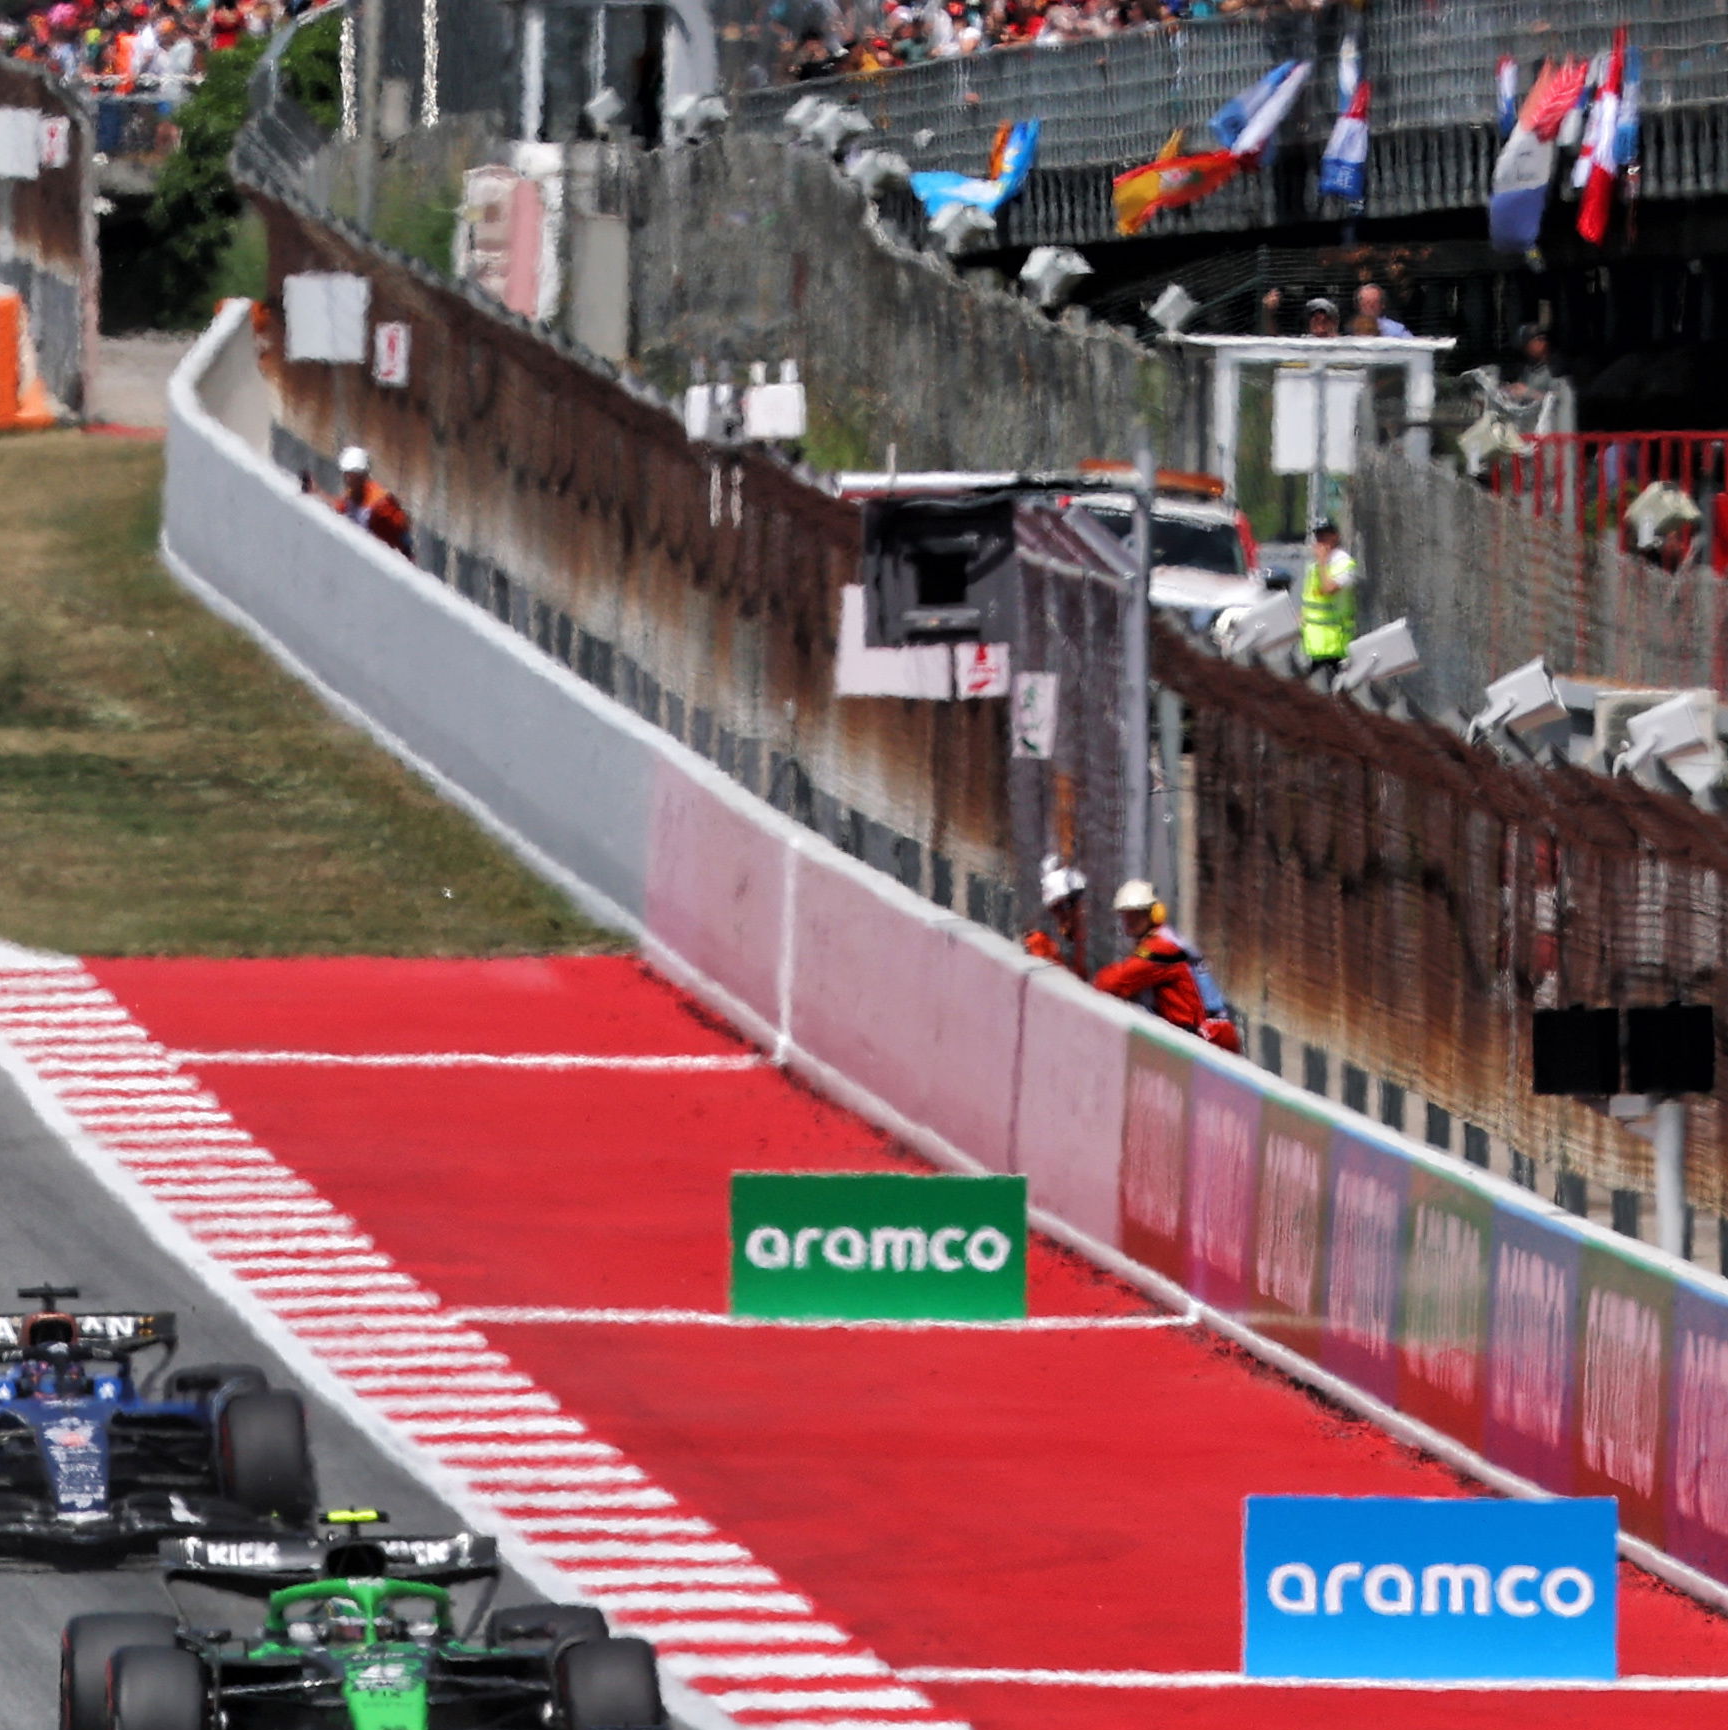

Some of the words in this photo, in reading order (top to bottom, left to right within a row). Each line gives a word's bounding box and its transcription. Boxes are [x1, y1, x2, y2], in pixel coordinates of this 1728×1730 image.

[745, 1226, 1011, 1272] aramco
[205, 1541, 280, 1566] KICK
[1267, 1562, 1595, 1618] aramco
